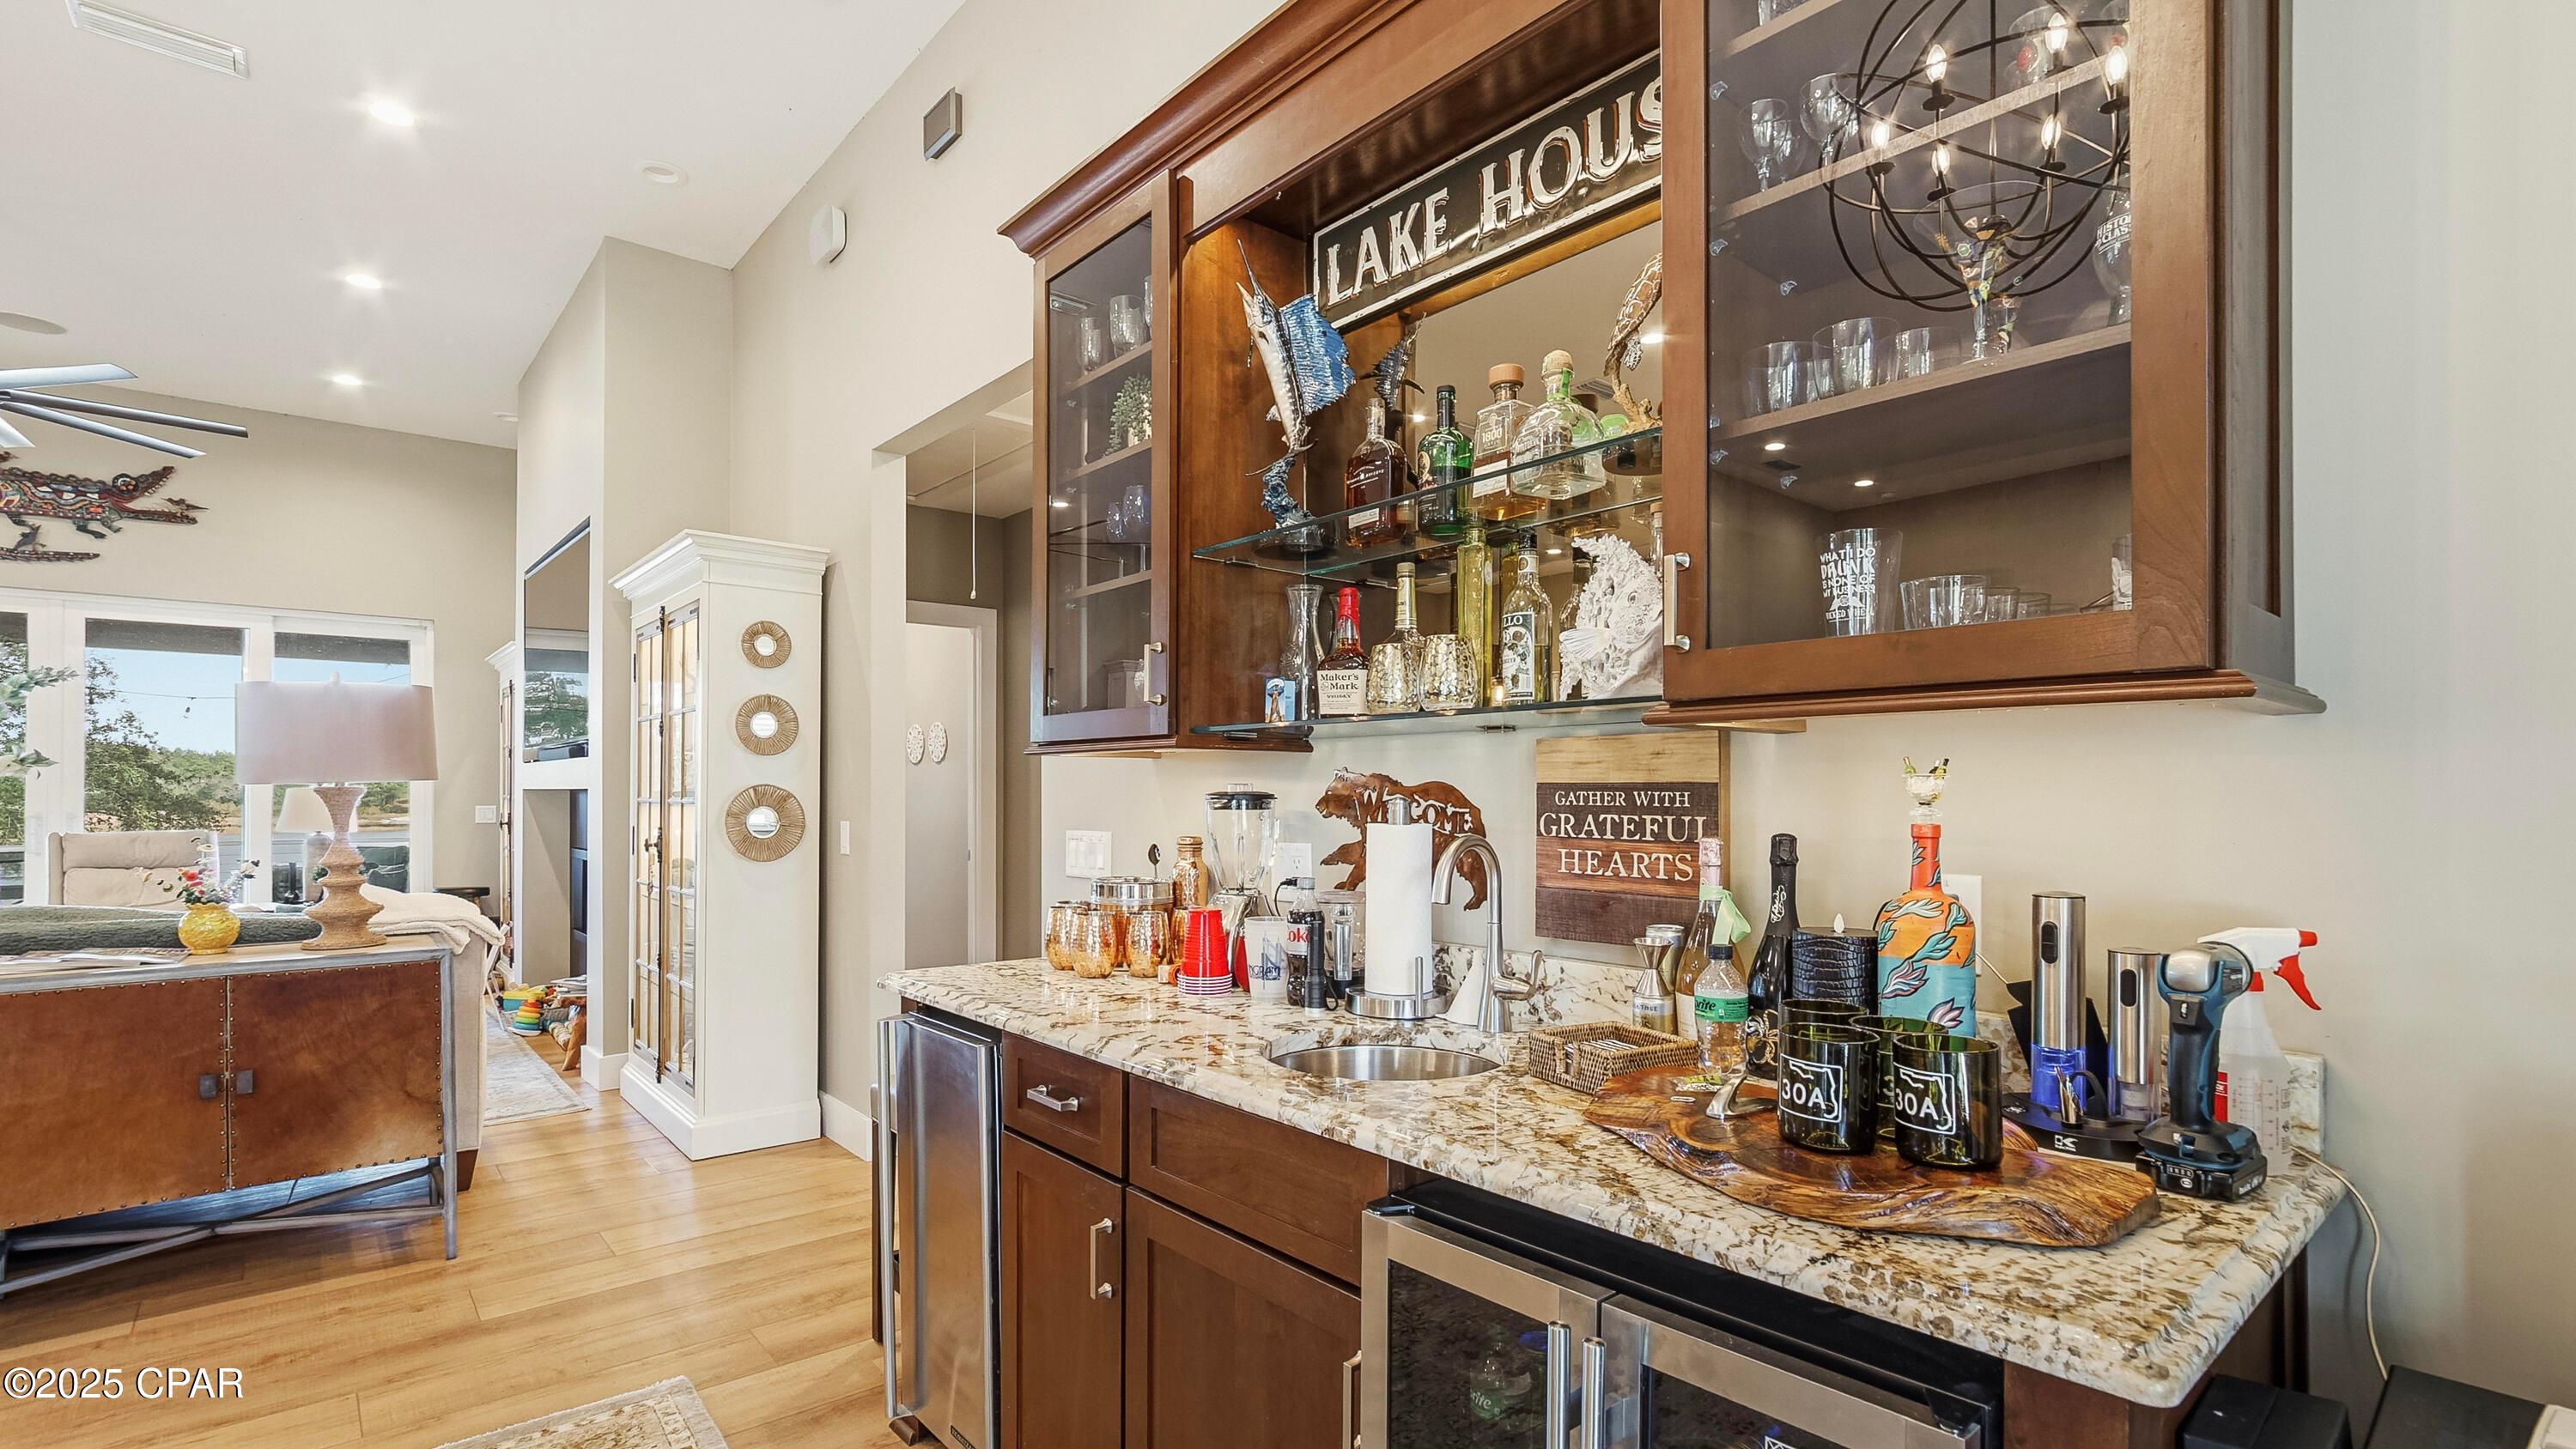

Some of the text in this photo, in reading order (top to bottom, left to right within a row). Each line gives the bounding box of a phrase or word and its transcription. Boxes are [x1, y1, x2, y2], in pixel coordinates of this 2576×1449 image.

[2097, 214, 2131, 239] HISTO
[1326, 186, 1453, 307] LAKE
[1482, 427, 1503, 443] 1800
[1856, 548, 1876, 558] DO
[1821, 556, 1876, 579] DRUNK
[1321, 673, 1359, 682] Maker's
[1353, 786, 1473, 834] WCOME
[1555, 791, 1691, 807] GATHER WITH
[1558, 848, 1693, 882] HEARTS
[1782, 1078, 1826, 1110] 30A
[1895, 1088, 1939, 1120] 30A
